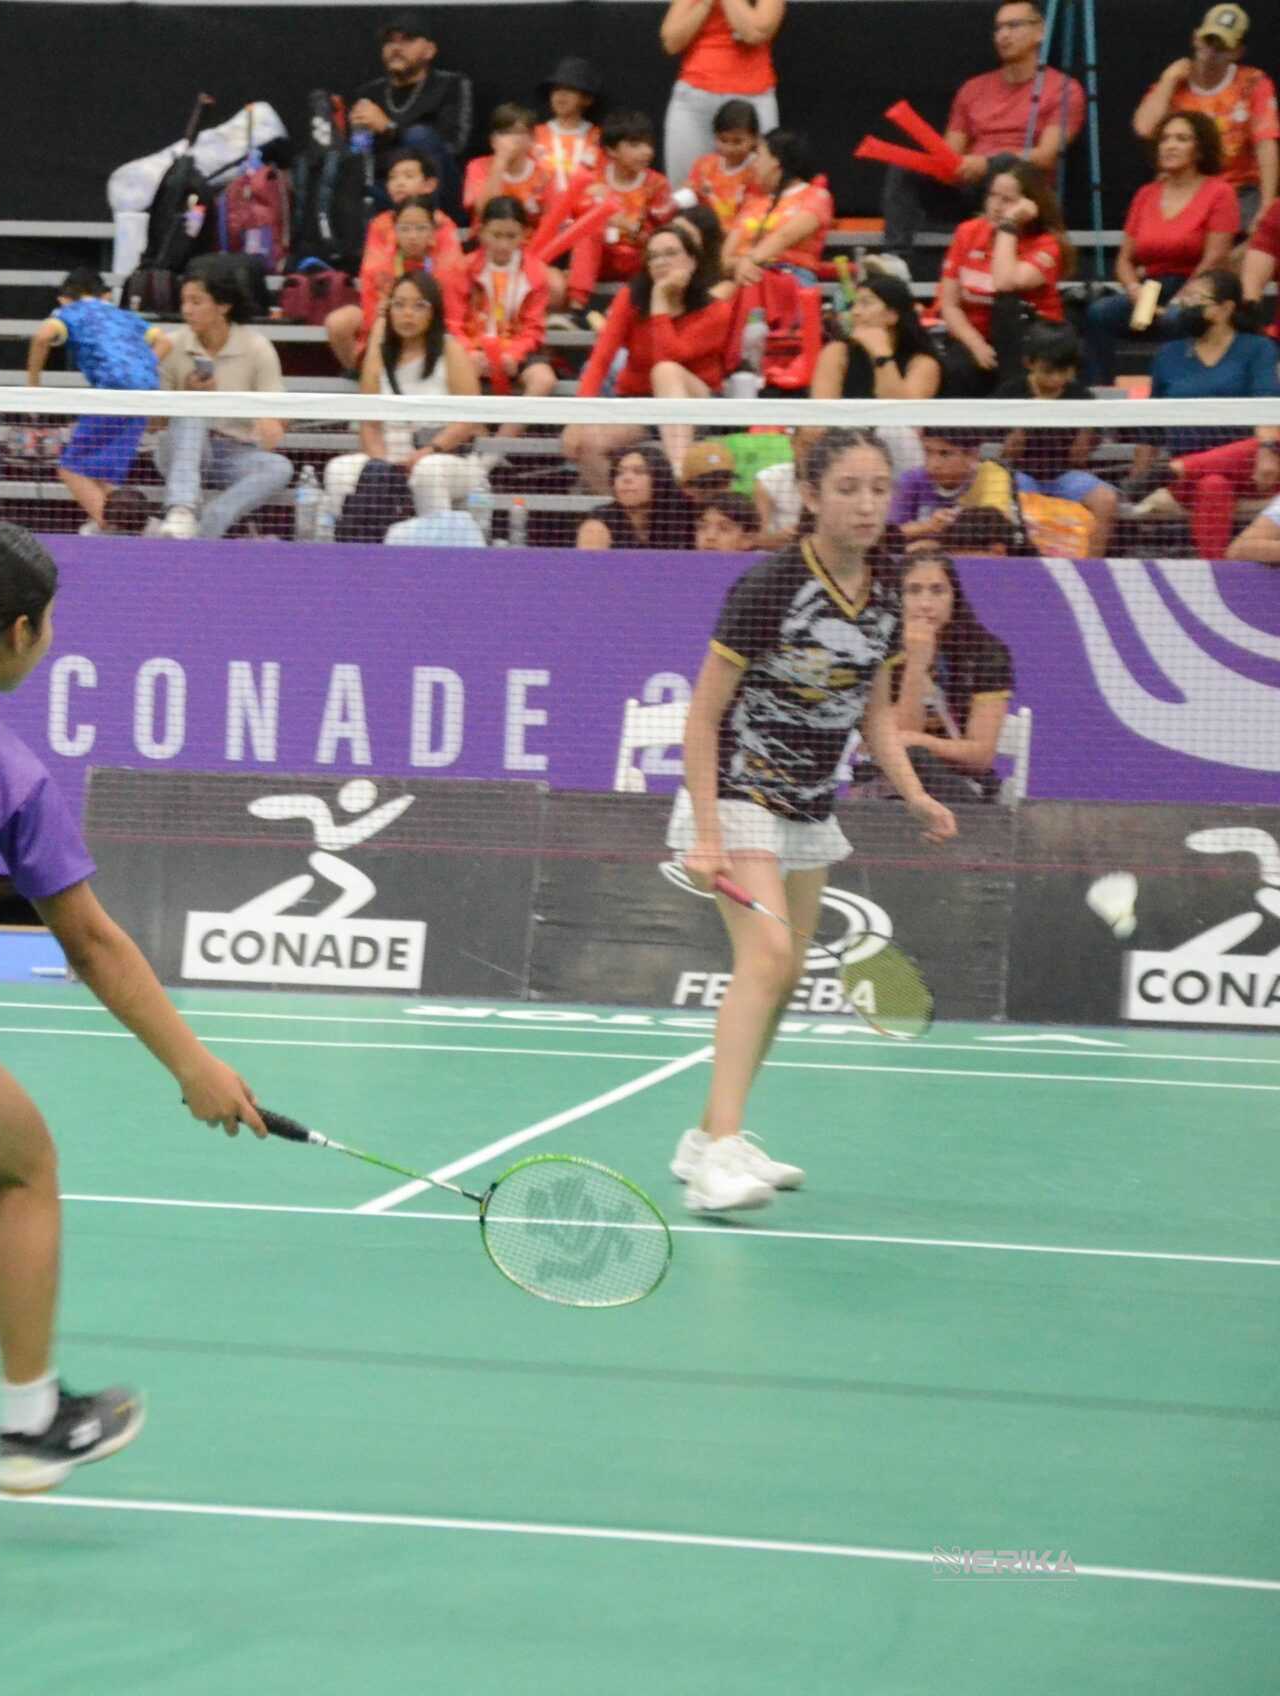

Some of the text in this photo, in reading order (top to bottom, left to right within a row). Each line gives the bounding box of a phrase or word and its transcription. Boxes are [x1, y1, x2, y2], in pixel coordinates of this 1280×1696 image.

[48, 655, 550, 770] CONADE
[199, 929, 409, 971] CONADE
[672, 971, 877, 1014] FEEBA
